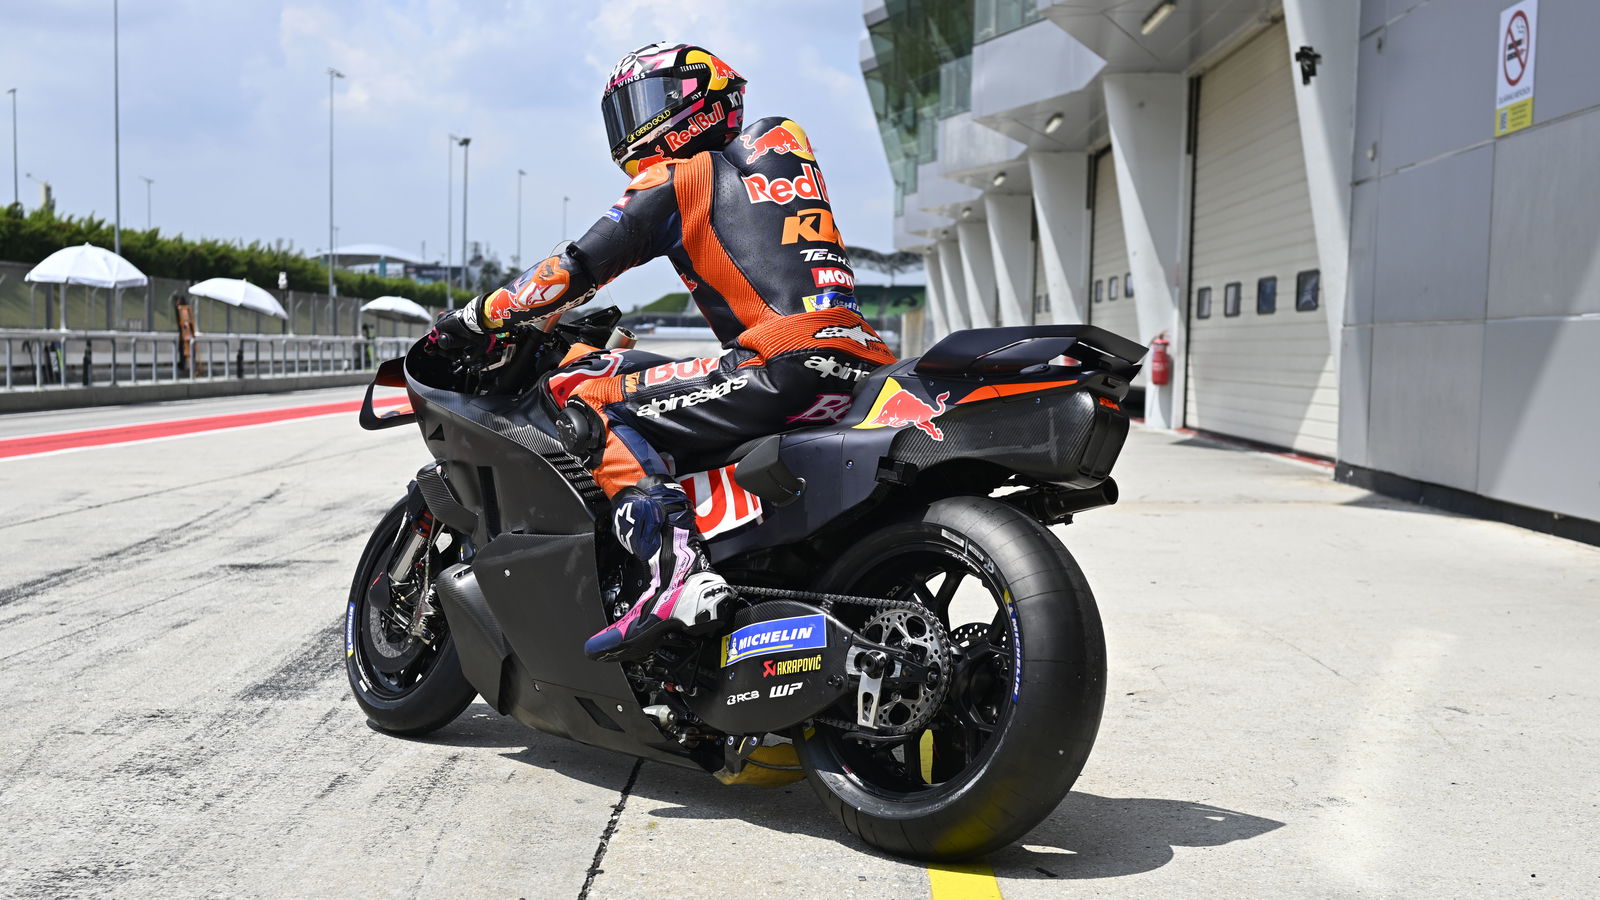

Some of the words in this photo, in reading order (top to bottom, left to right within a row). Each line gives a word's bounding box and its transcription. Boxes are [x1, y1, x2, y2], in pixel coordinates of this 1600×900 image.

[617, 72, 646, 88] WINGS
[652, 109, 672, 126] GOLD
[664, 116, 702, 152] Red
[695, 101, 725, 131] Bull
[741, 163, 822, 205] Red
[818, 270, 854, 287] MOT
[636, 374, 748, 419] alpinestars
[738, 626, 813, 651] MICHELIN
[1011, 617, 1025, 696] MICHELIN
[769, 681, 804, 698] WP
